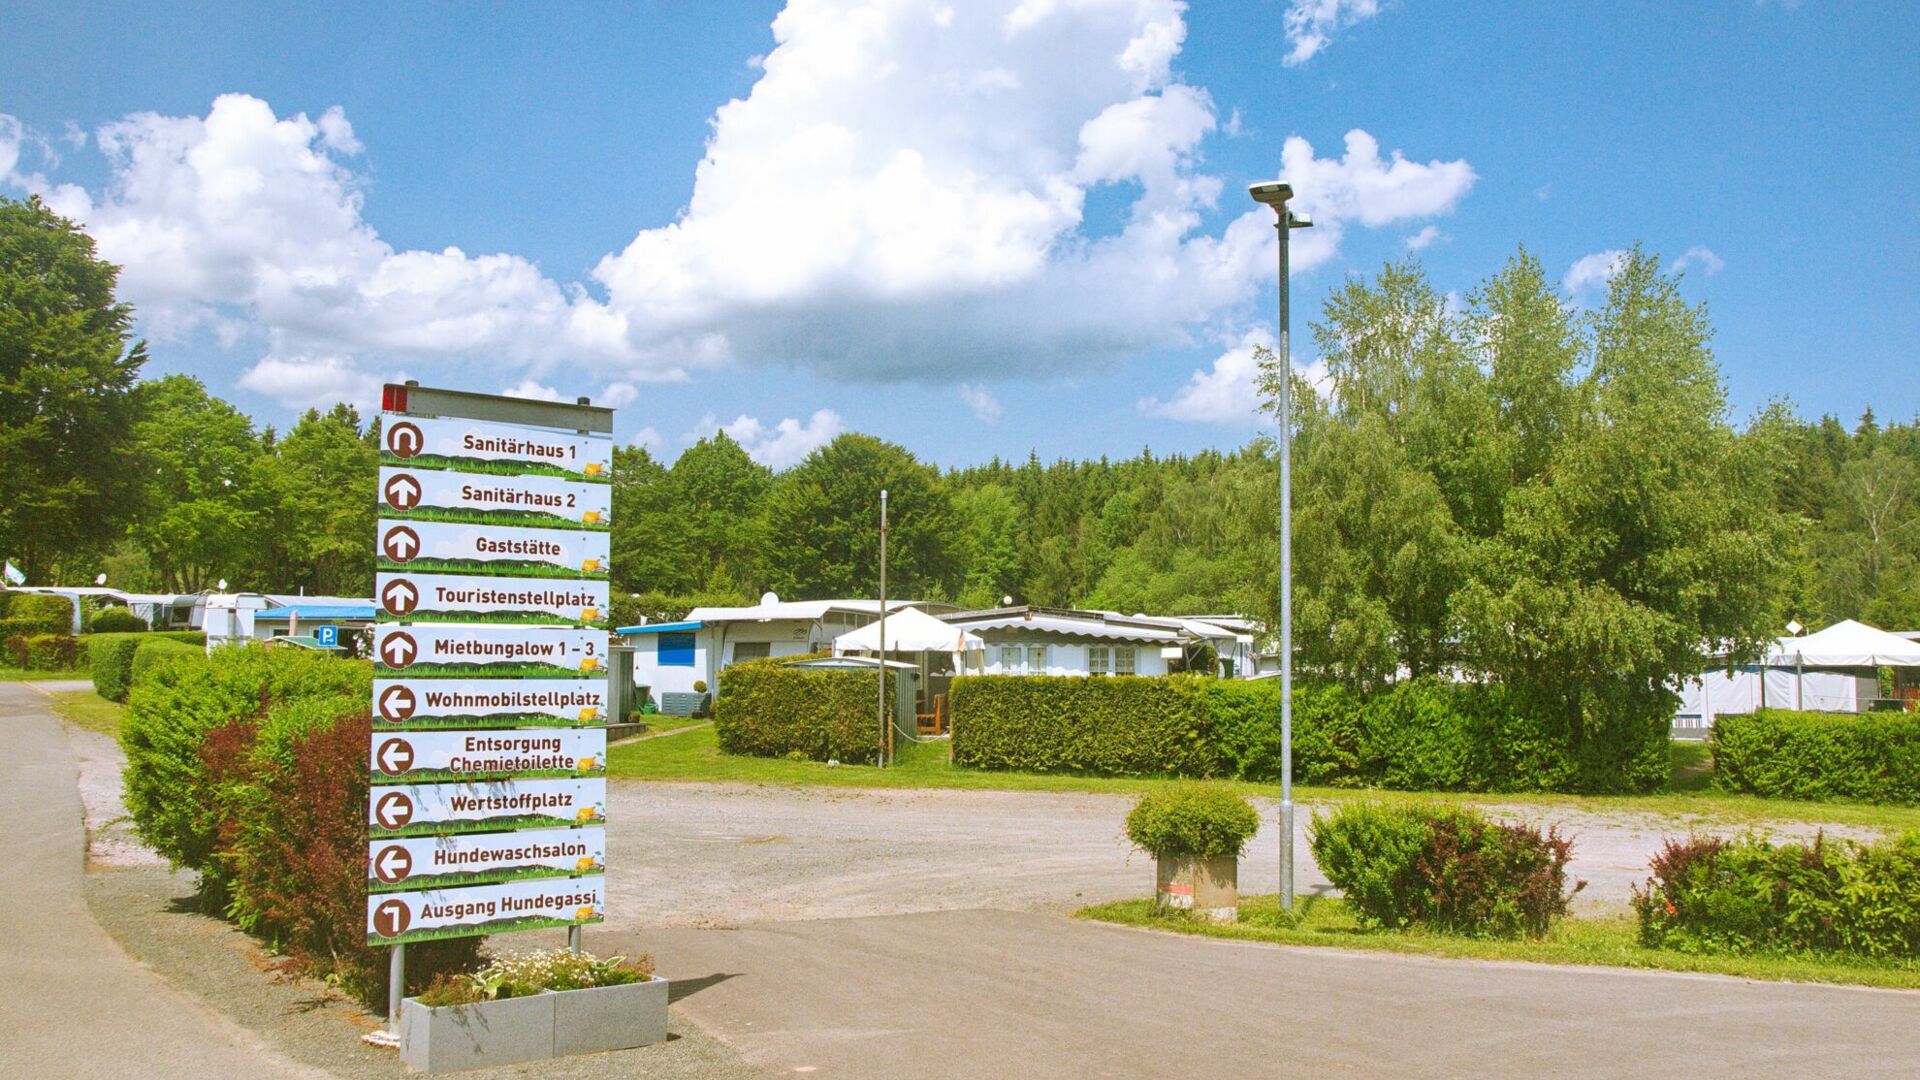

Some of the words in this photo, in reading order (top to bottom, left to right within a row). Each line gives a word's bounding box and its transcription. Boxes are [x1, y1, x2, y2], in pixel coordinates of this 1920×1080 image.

[463, 434, 564, 458] Sanitärhaus
[569, 445, 576, 459] 1
[462, 485, 562, 507] Sanitärhaus
[567, 494, 576, 508] 2
[476, 537, 561, 555] Gaststätte
[436, 587, 595, 608] Touristenstellplatz
[323, 628, 333, 643] P
[434, 639, 554, 659] Mietbungalow
[558, 642, 565, 656] 1
[586, 642, 594, 656] 3
[425, 691, 600, 709] Wohnmobilstellplatz
[465, 737, 561, 753] Entsorgung
[450, 755, 574, 773] Chemietoilette
[450, 793, 572, 811] Wertstoffplatz
[434, 842, 586, 865] Hundewaschsalon
[420, 900, 497, 920] Ausgang
[501, 889, 596, 913] Hundegassi
